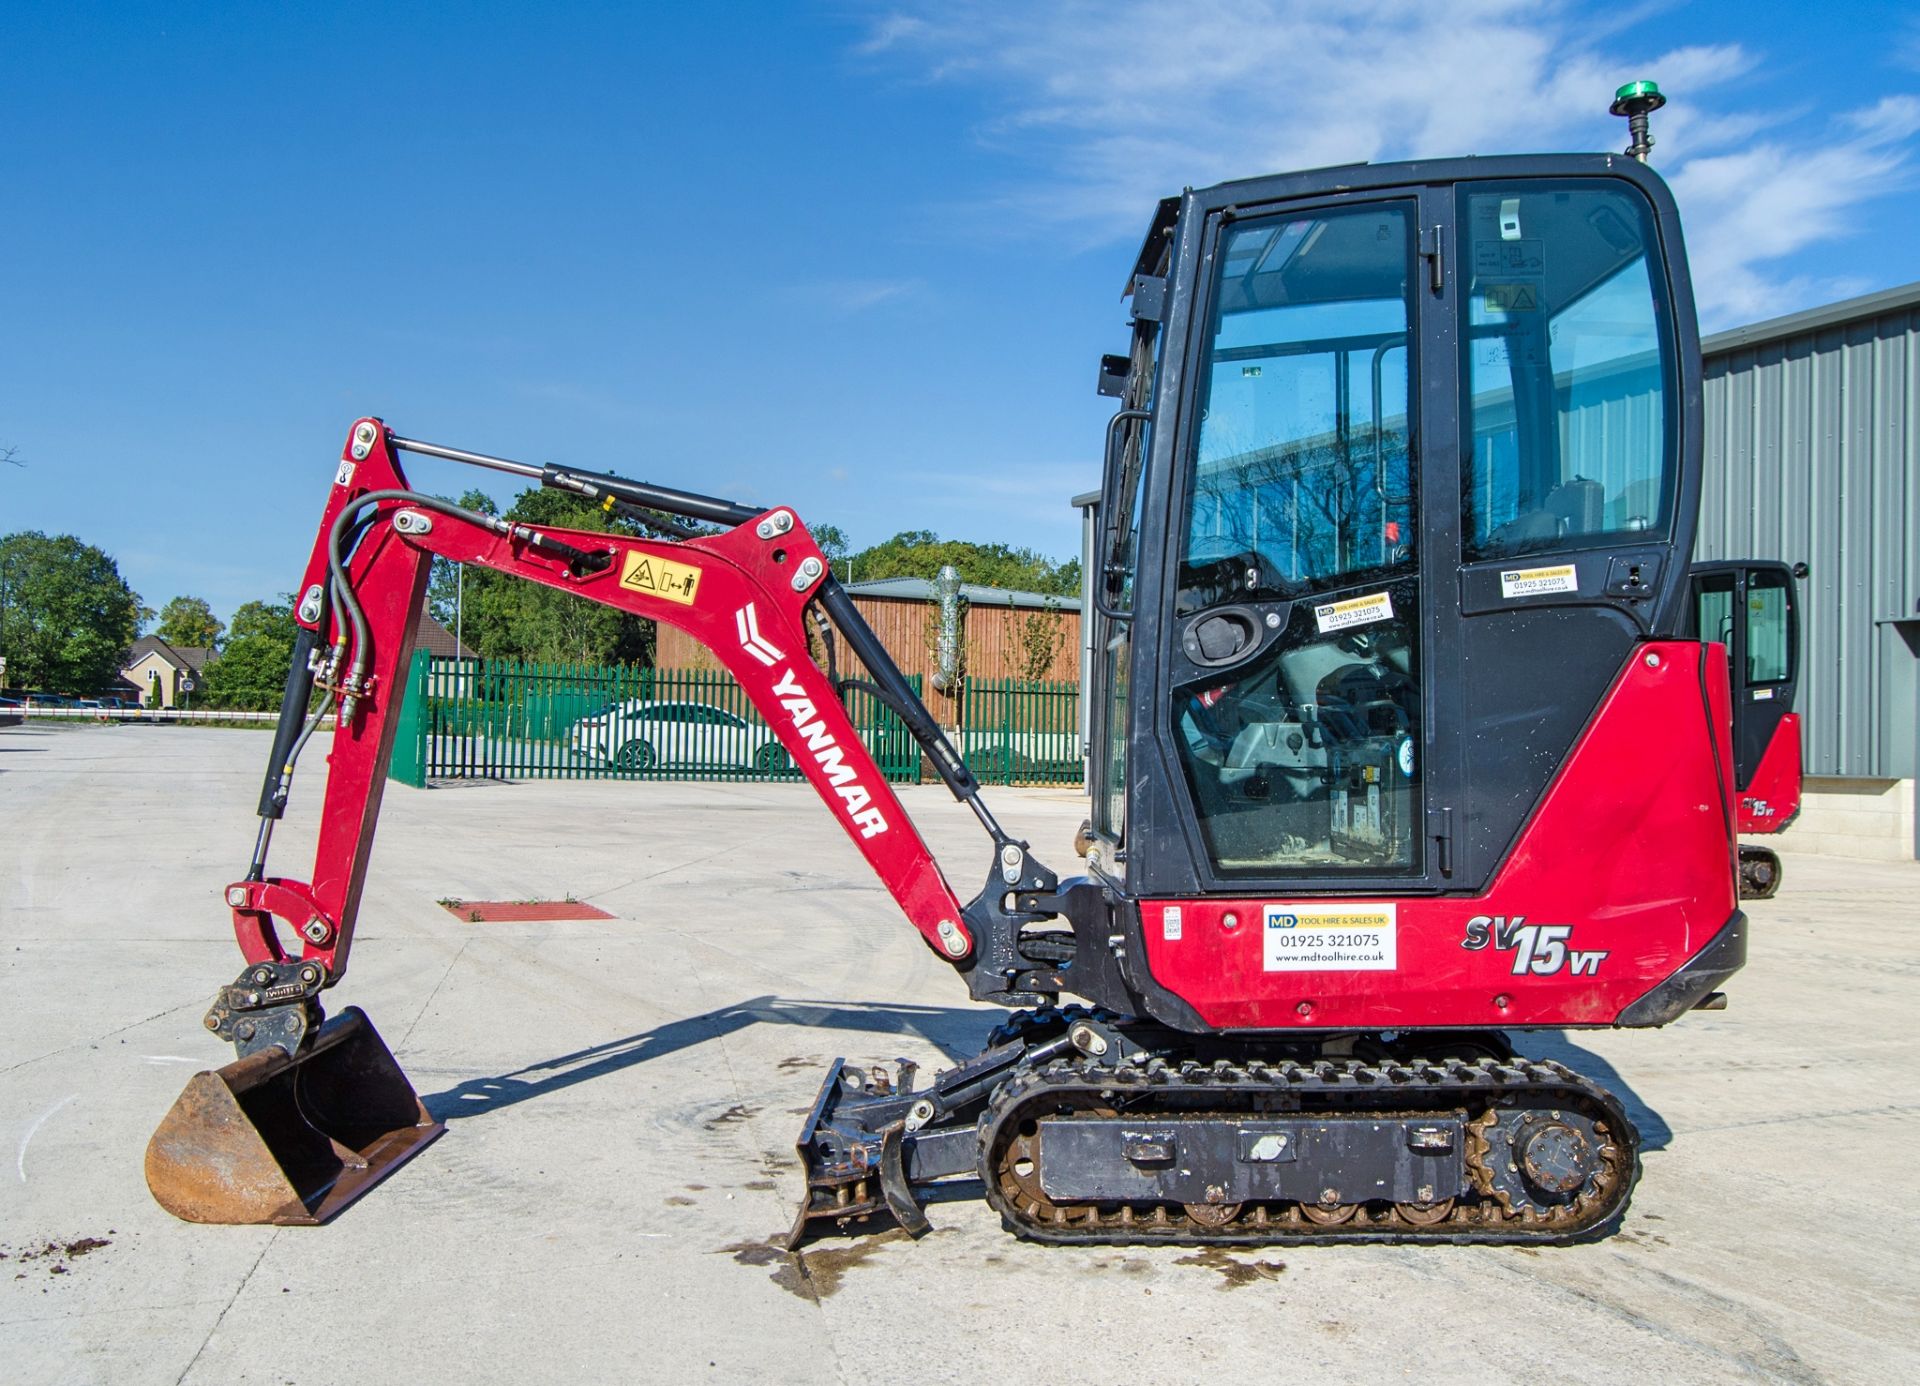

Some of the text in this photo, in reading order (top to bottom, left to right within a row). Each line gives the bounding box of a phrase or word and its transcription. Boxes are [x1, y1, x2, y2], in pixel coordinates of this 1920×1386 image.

[1505, 574, 1519, 582] MD
[1514, 577, 1566, 589] 01925 321075
[1319, 607, 1333, 616] MD
[1329, 606, 1380, 622] 01925 321075
[771, 668, 888, 839] YANMAR
[1270, 915, 1385, 928] MD TOOL HIRE & SALES UK
[1280, 934, 1380, 947] 01925 321075
[1275, 951, 1385, 963] www.mdtoolhire.co.uk
